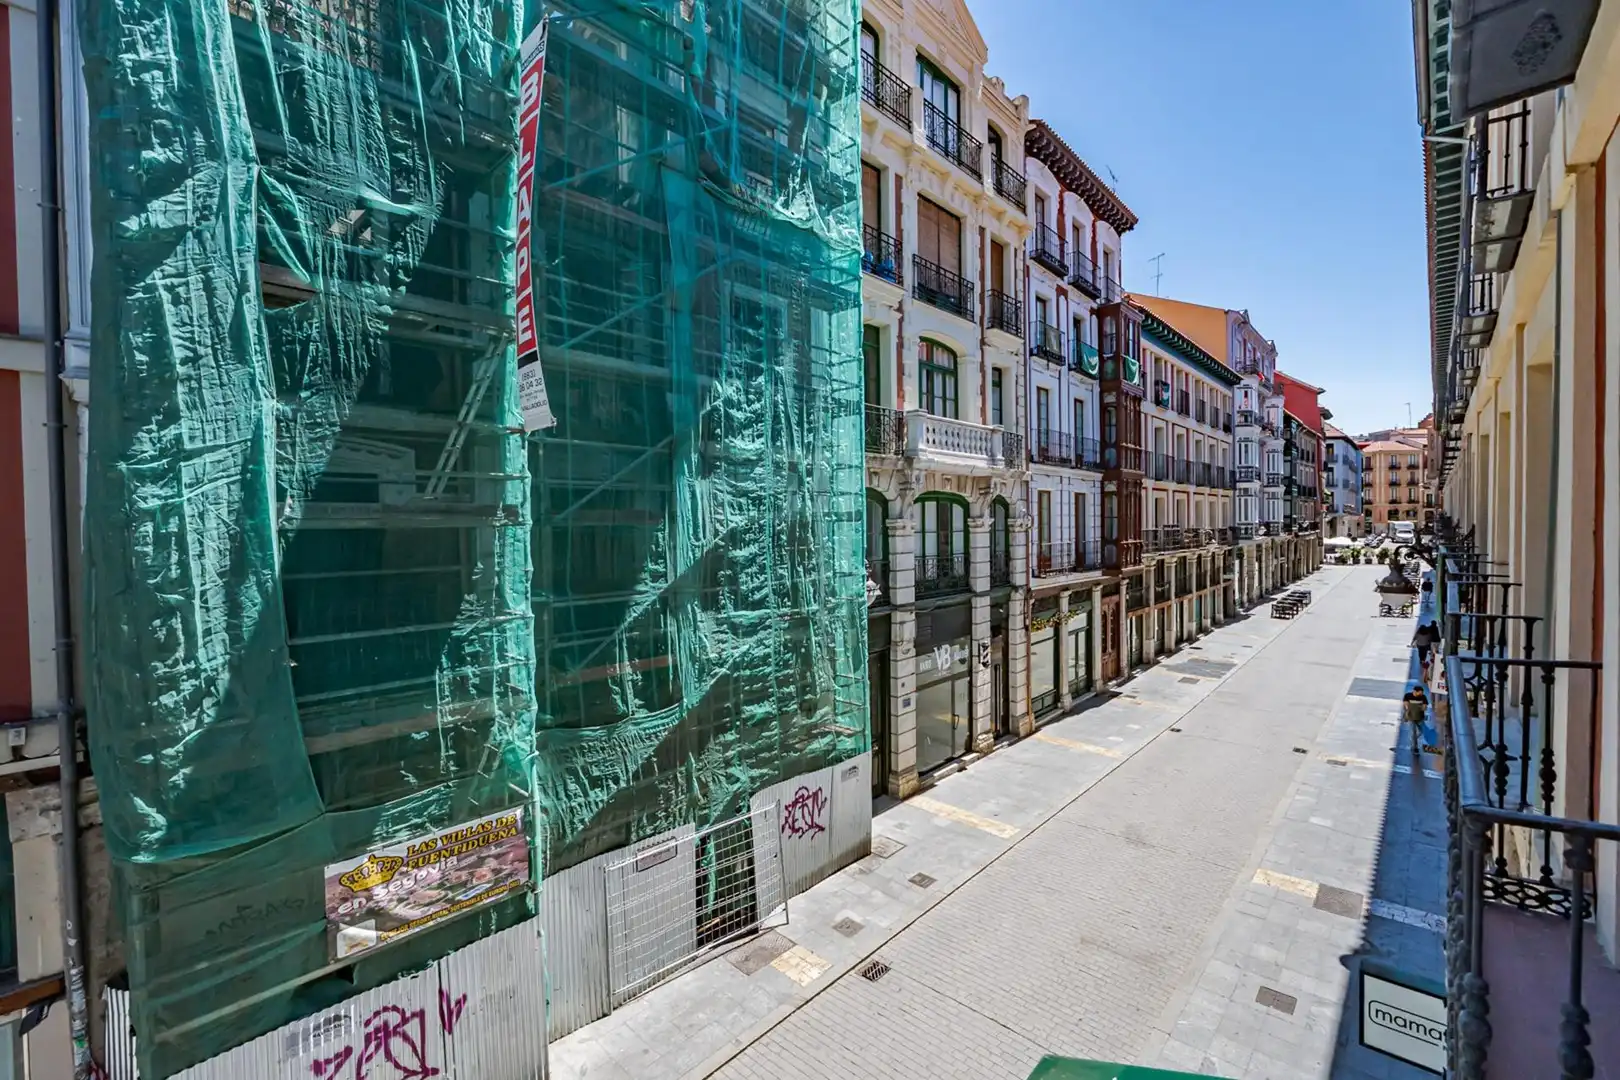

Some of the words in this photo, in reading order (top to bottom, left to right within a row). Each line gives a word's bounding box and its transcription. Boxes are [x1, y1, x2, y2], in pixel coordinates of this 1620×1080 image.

[517, 70, 539, 345] BLAPE
[406, 838, 437, 858] LAS
[440, 820, 493, 849] VILLAS
[496, 814, 517, 829] DE
[337, 897, 367, 915] en
[372, 855, 458, 900] Segovia
[1375, 1008, 1446, 1041] mama
